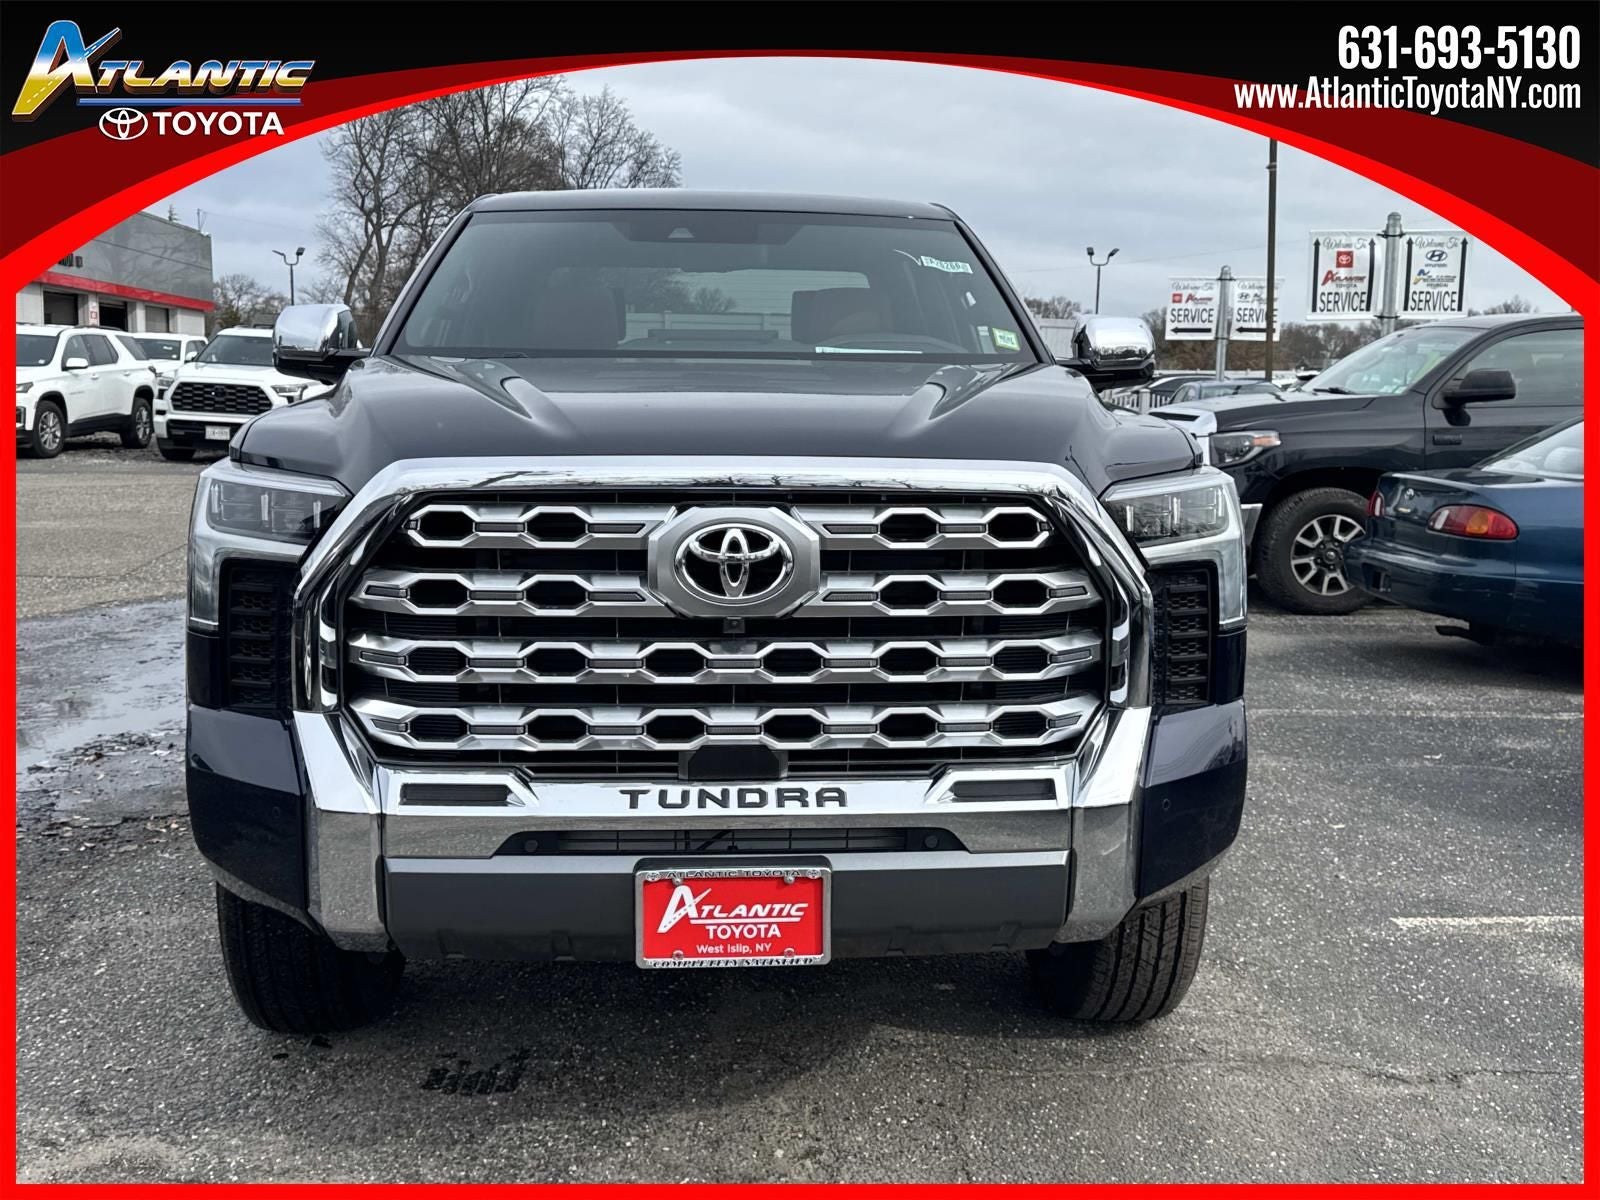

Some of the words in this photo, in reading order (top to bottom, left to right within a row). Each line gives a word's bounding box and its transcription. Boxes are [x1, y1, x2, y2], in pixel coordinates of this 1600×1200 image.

[1319, 292, 1367, 312] SERVICE
[1410, 291, 1457, 312] SERVICE
[1170, 308, 1214, 323] SERVICE
[619, 787, 848, 809] TUNDRA
[666, 870, 738, 879] ATLANTIC
[743, 869, 801, 878] TOYOTA
[657, 885, 809, 933] ATLANTIC
[705, 923, 782, 940] TOYOTA
[696, 944, 724, 954] West
[727, 943, 753, 954] Islip,
[755, 942, 772, 953] NY
